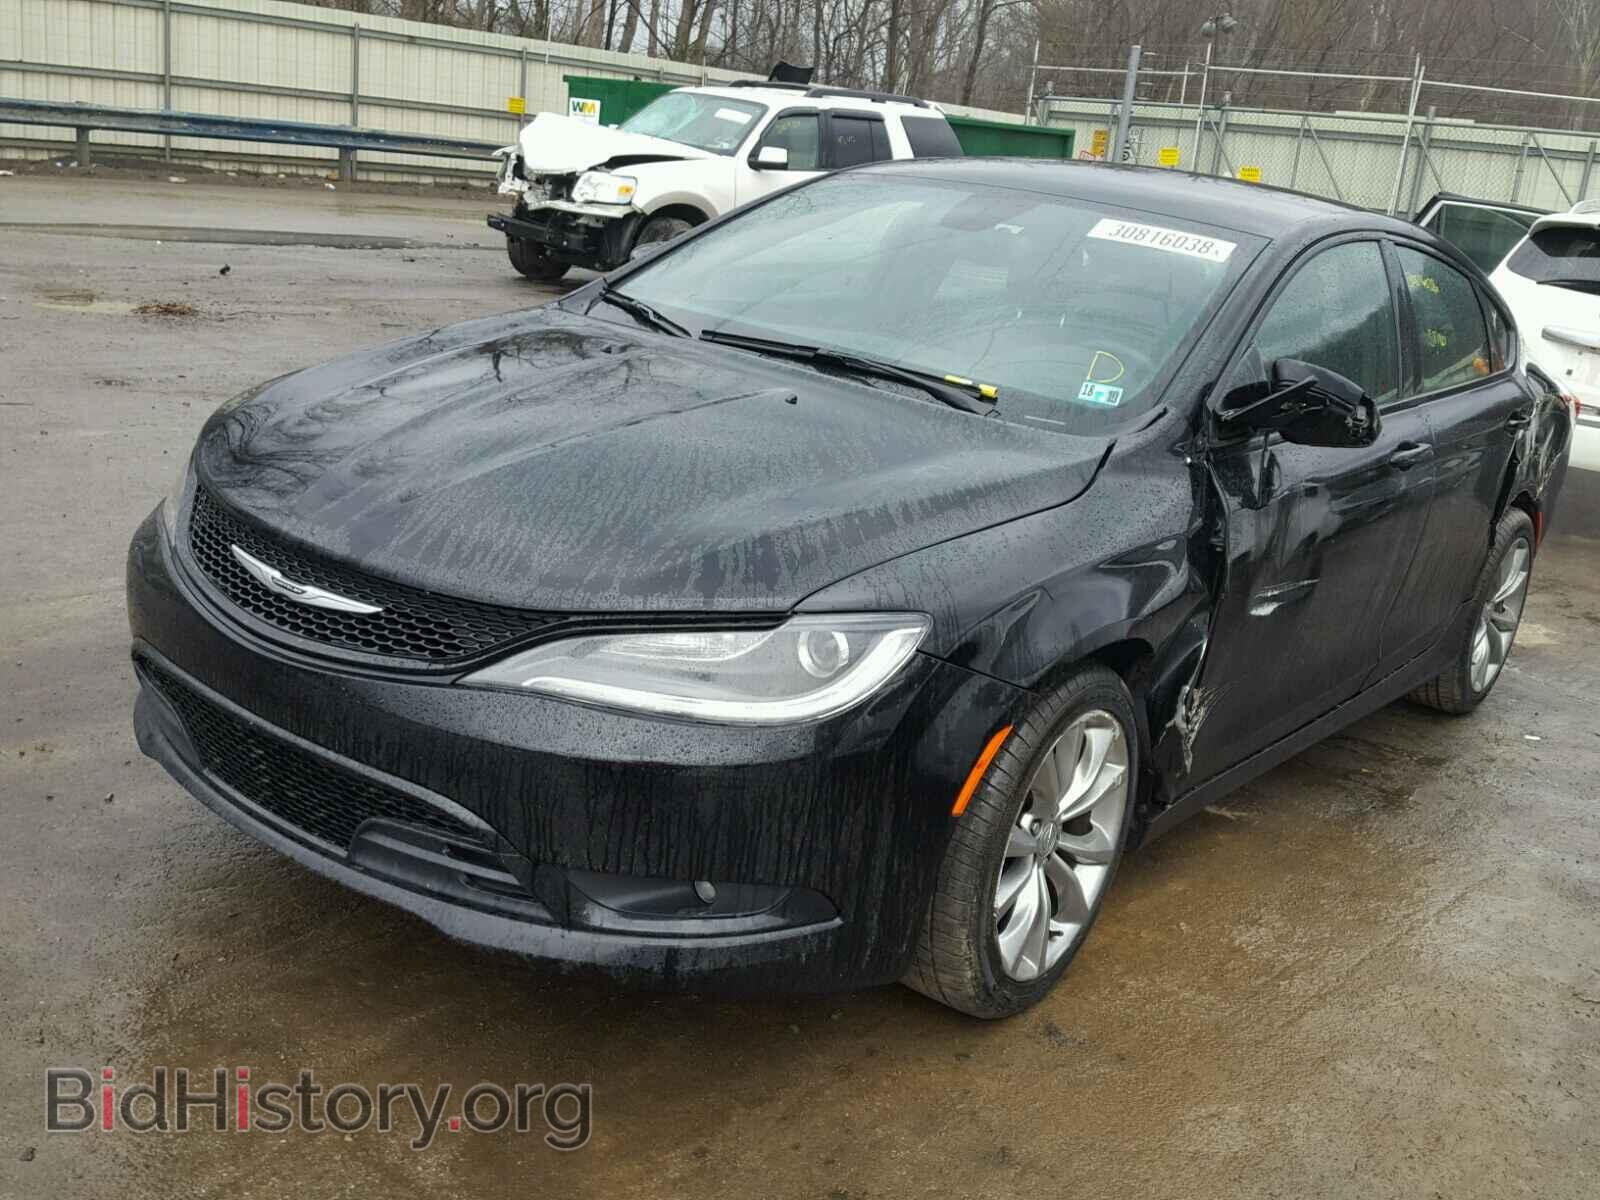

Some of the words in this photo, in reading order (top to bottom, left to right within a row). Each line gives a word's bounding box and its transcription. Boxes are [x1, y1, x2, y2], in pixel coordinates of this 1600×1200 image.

[572, 100, 596, 113] WM
[1108, 225, 1214, 254] 30816038
[1087, 351, 1124, 383] D
